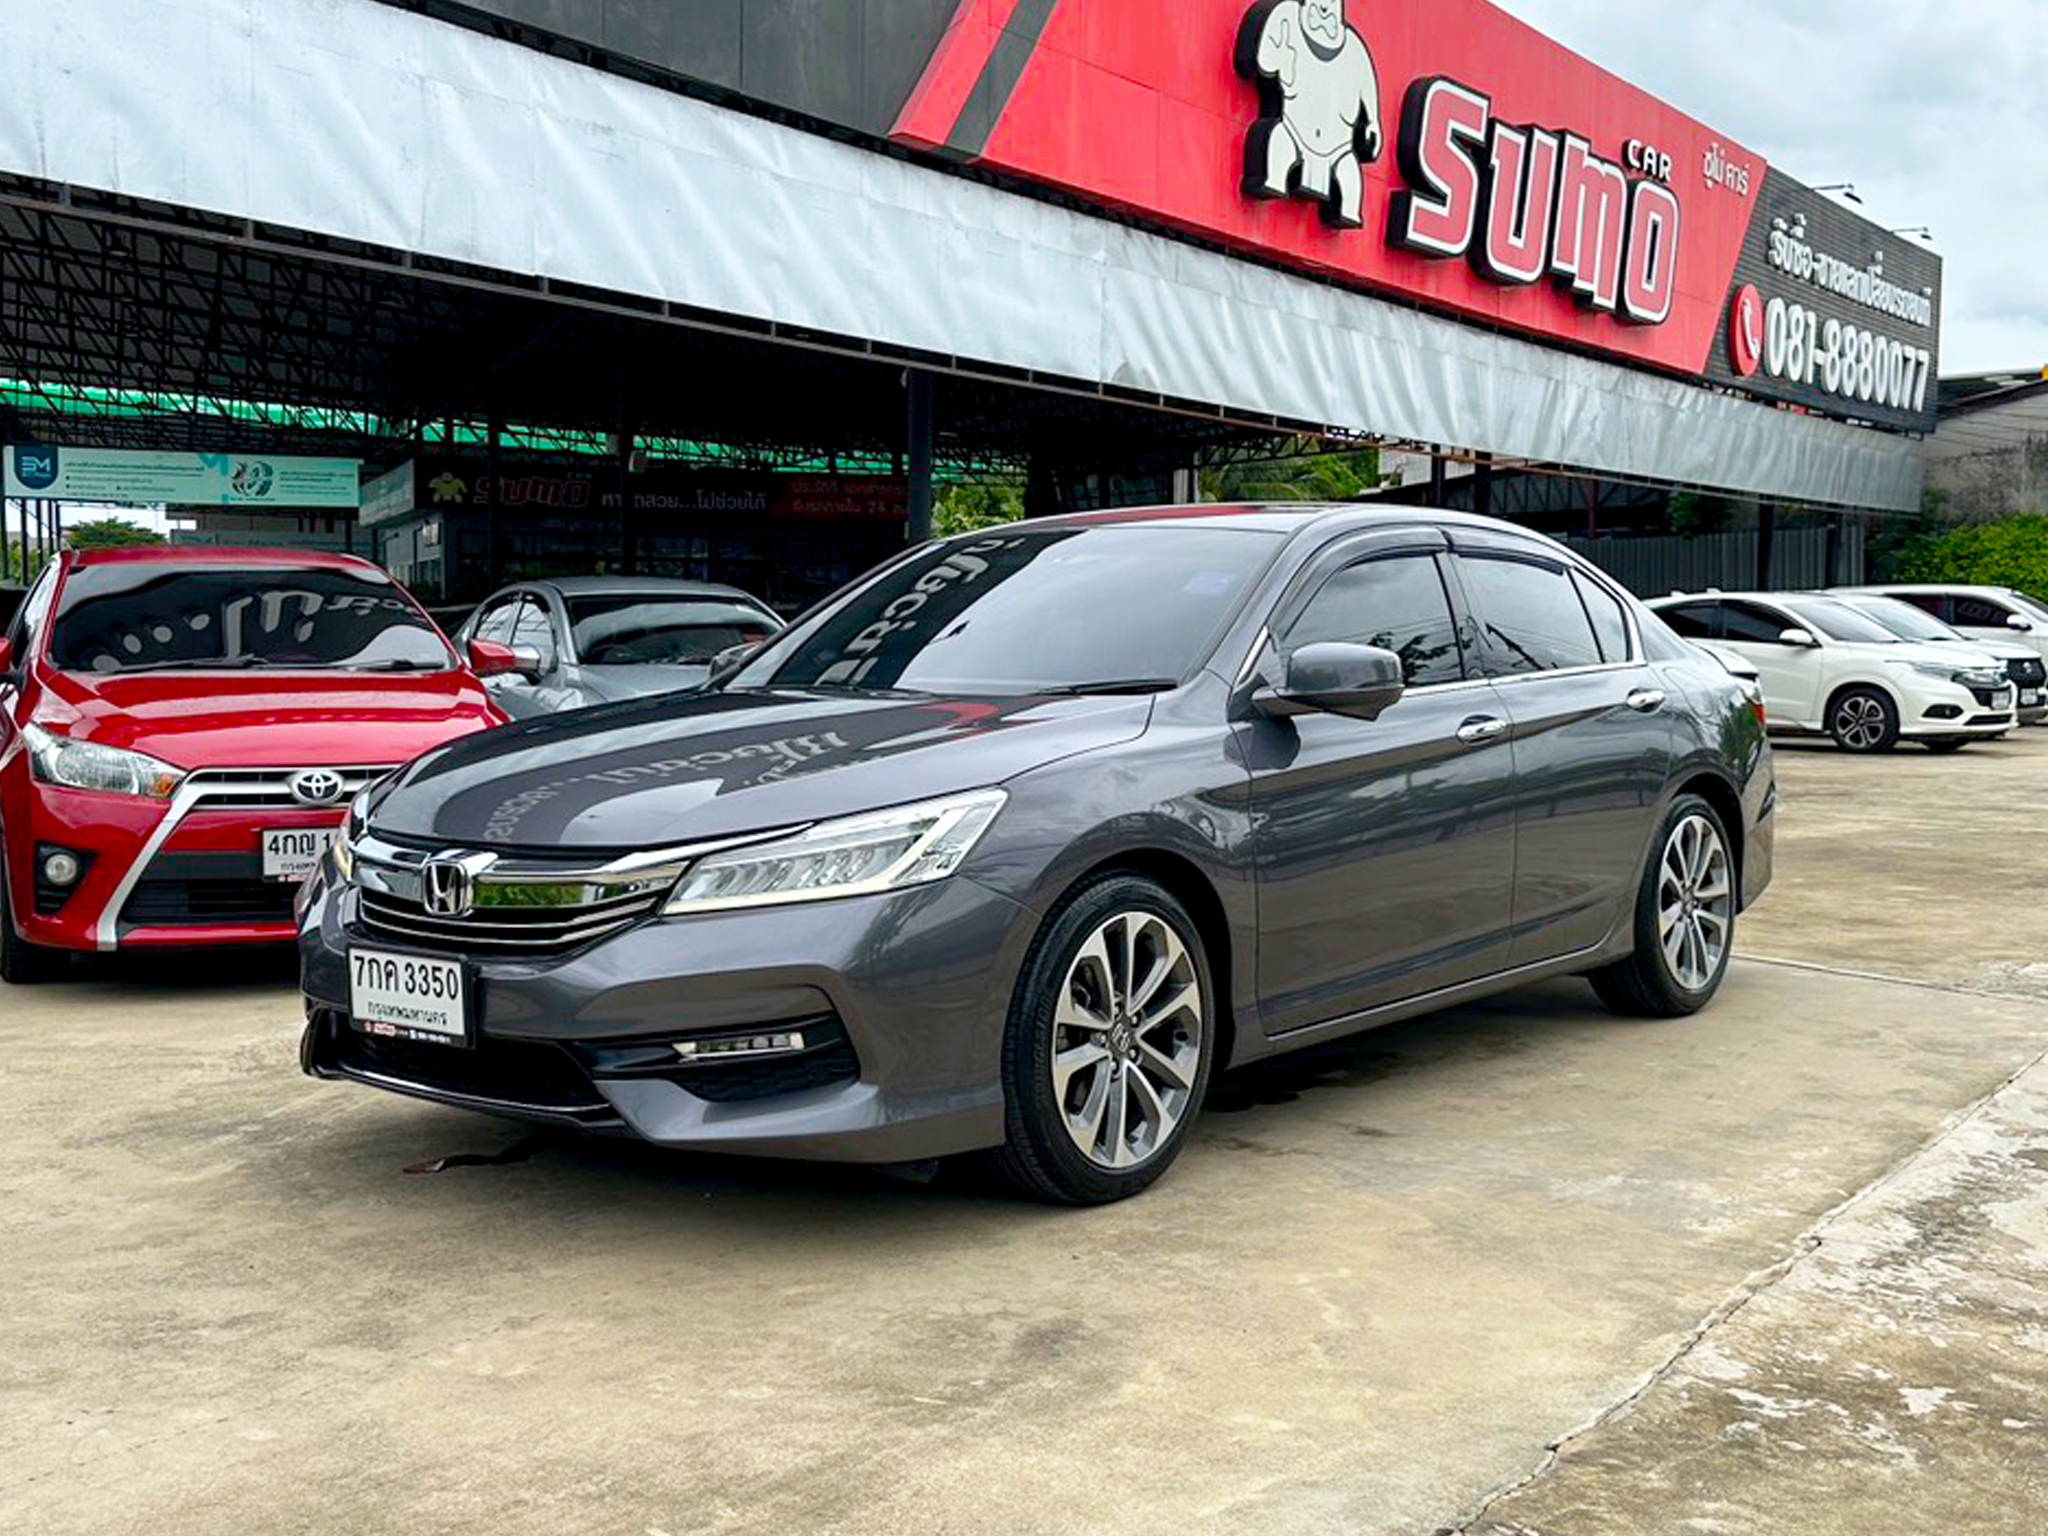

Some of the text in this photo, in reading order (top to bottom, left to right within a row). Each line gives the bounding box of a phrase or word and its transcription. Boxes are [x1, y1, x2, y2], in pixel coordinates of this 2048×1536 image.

[1625, 138, 1672, 182] CAR
[1764, 296, 1930, 413] 081-8880077
[268, 832, 316, 856] 4กญ
[353, 954, 459, 1000] 7กค 3350
